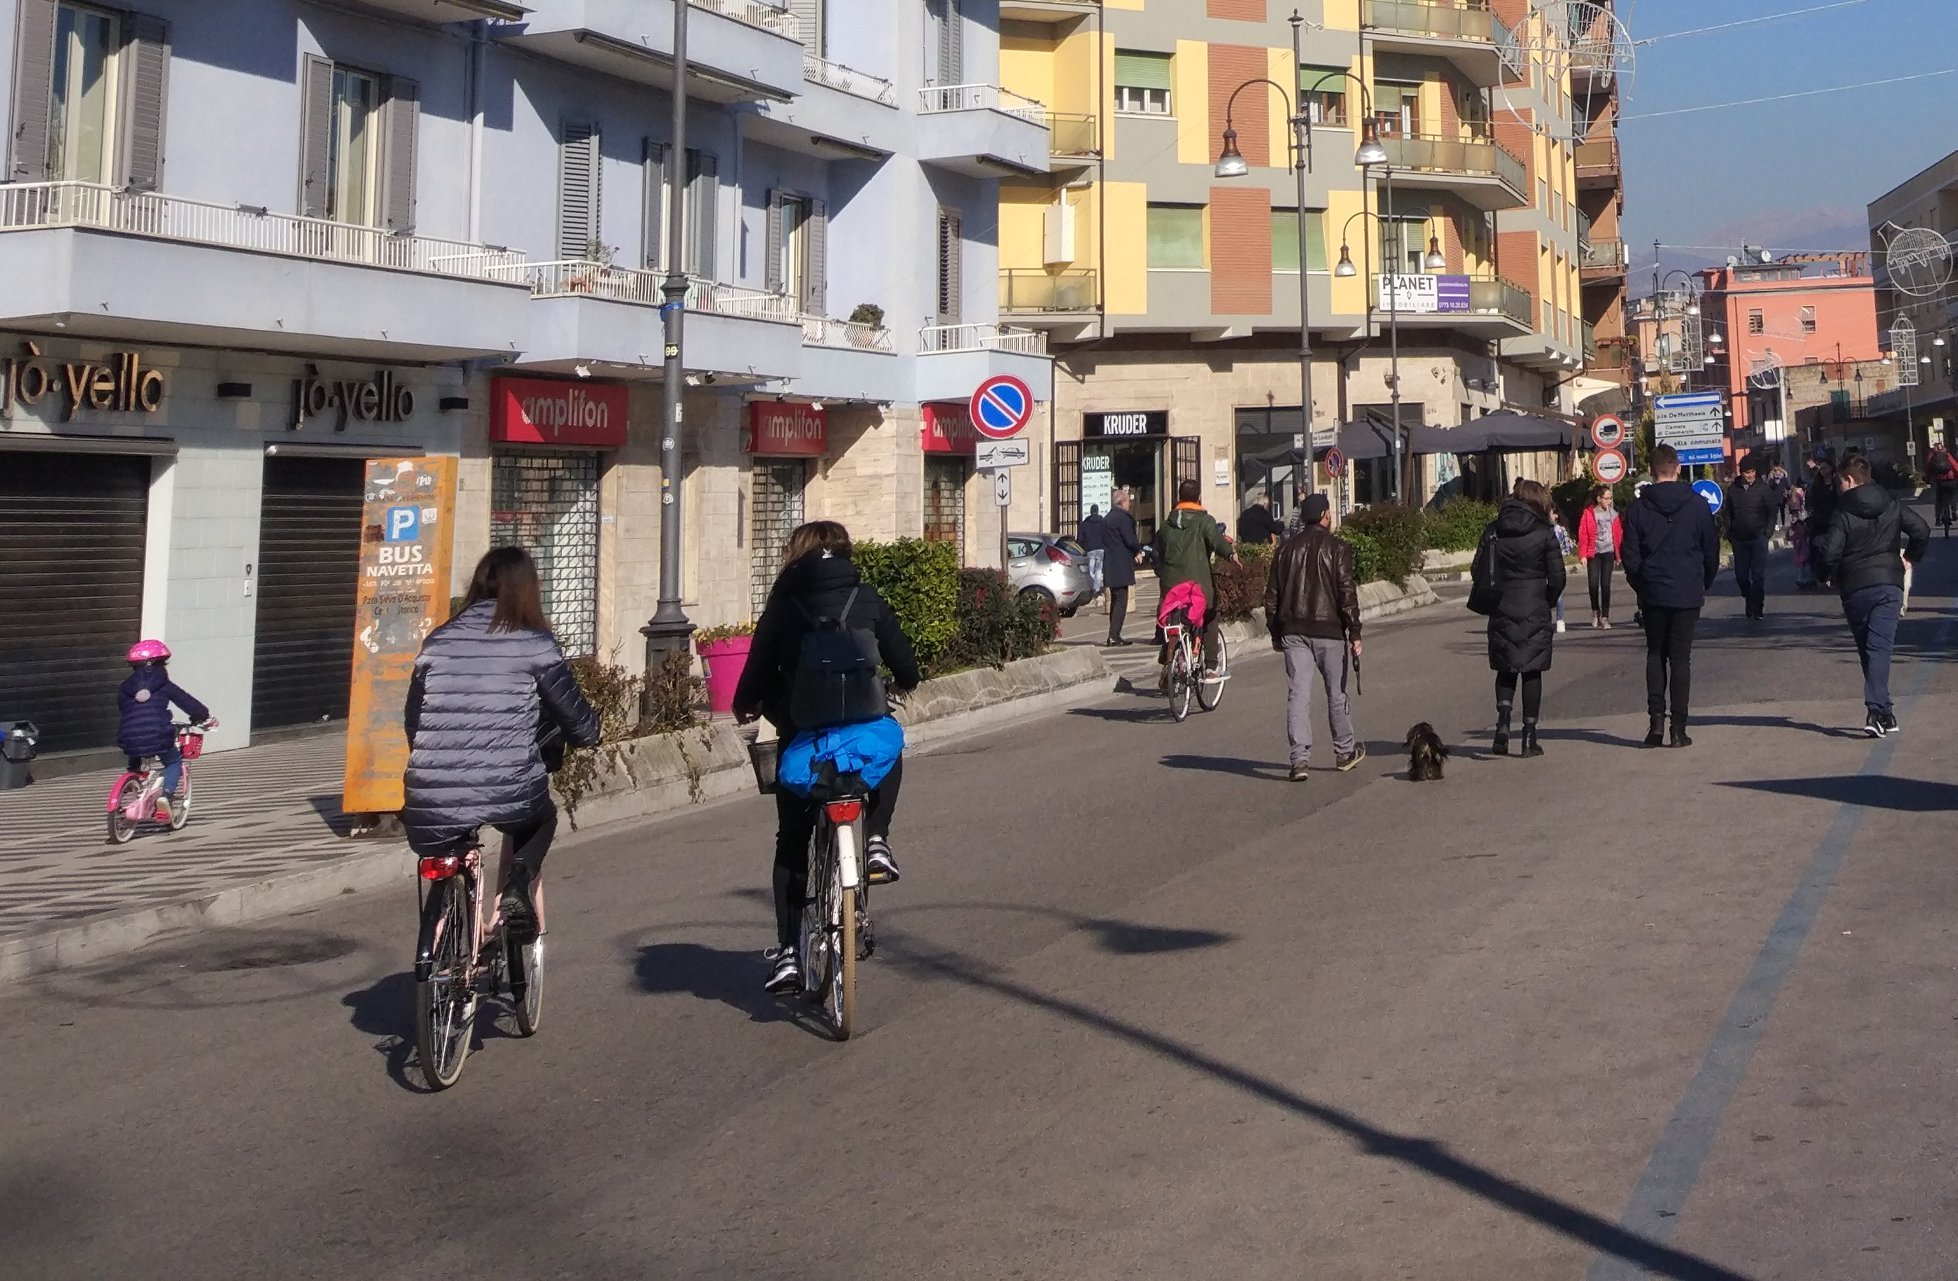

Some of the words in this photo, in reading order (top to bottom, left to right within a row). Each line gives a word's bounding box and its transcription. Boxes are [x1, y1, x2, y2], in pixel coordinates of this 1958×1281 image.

[521, 388, 608, 436] amplifon
[1103, 414, 1147, 435] KRUDER
[763, 408, 822, 447] amplifon
[932, 411, 976, 445] amplifo
[1082, 456, 1110, 470] KRUDER
[391, 509, 415, 539] P
[379, 545, 423, 564] BUS
[366, 563, 433, 578] NAVETTA
